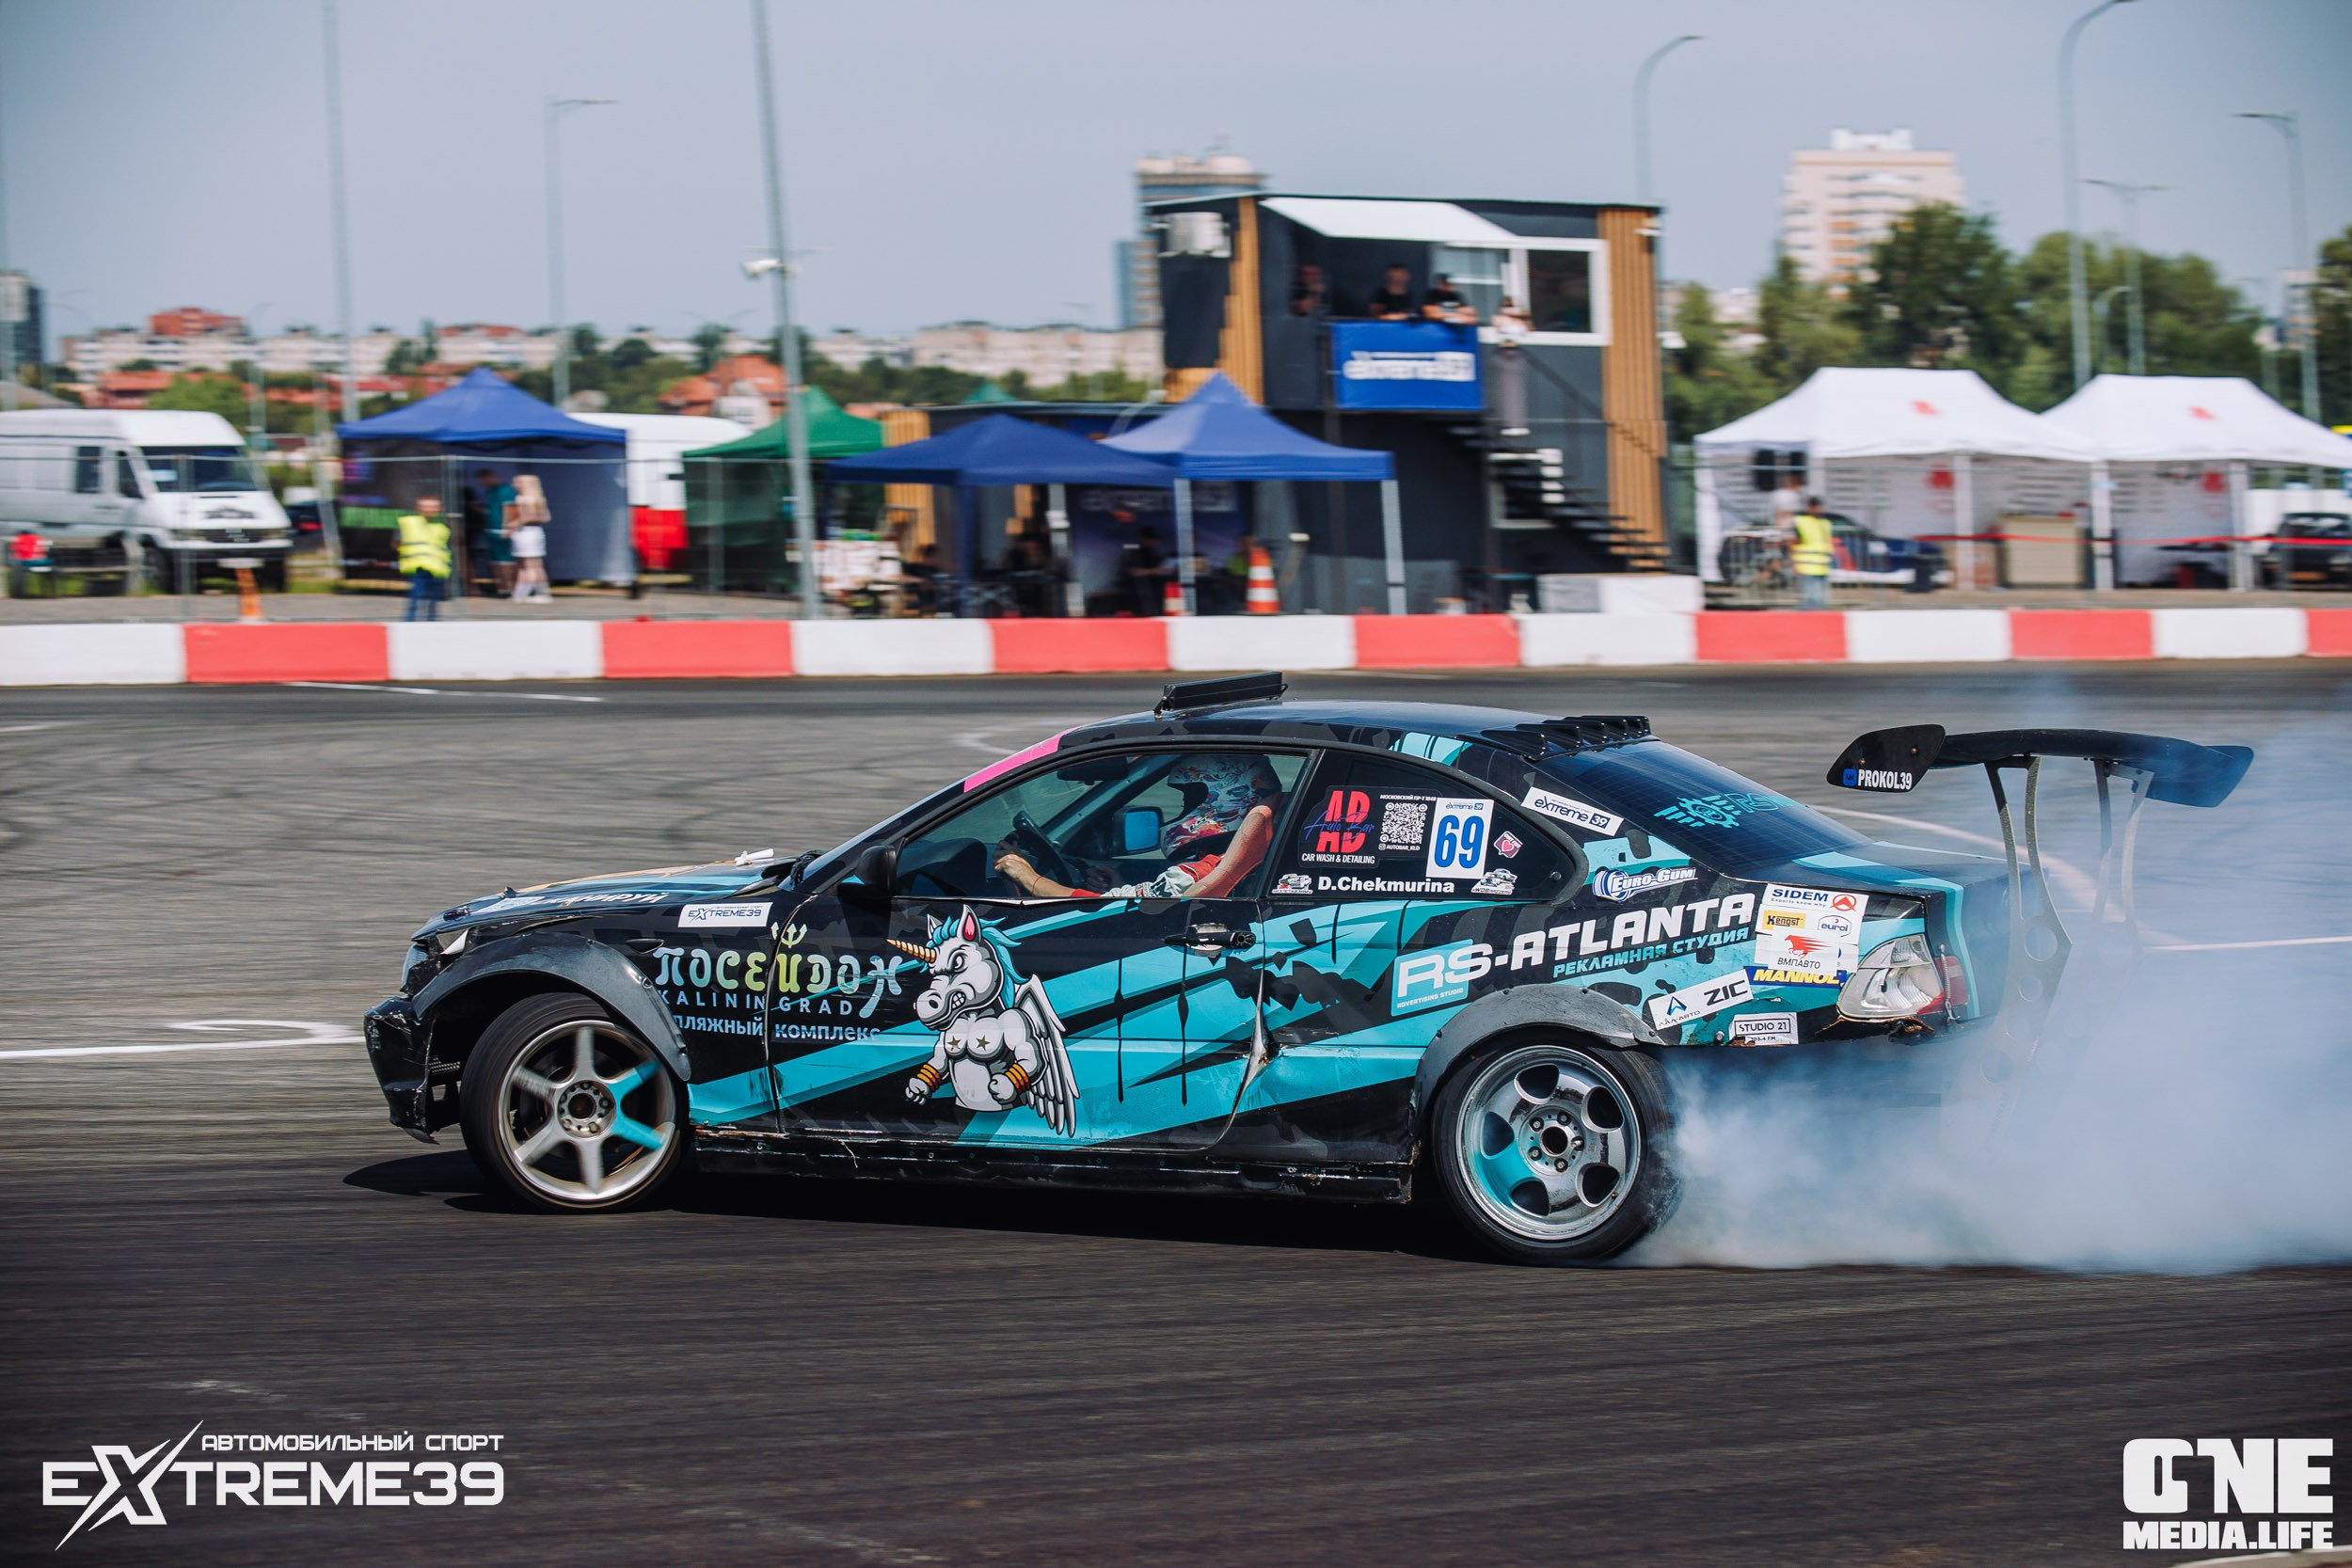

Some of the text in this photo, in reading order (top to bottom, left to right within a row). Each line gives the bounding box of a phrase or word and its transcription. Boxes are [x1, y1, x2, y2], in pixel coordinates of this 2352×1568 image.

[1857, 768, 1913, 790] PROKOL39
[1590, 814, 1610, 827] 39
[1434, 815, 1485, 869] 69
[1301, 852, 1375, 864] CAR WASH & DETAILING
[1318, 876, 1455, 894] D.Chekmurina
[1772, 888, 1829, 902] SIDEM
[1820, 923, 1849, 932] eurol
[1397, 893, 1756, 998] RS-ATLANTA
[1552, 927, 1750, 979] РЕКЛАМНАЯ СТУДИЯ
[1777, 958, 1821, 970] ВМПАВТО
[1753, 969, 1840, 985] MANNOL
[1396, 987, 1464, 1009] ADVERTISING STUDIO
[1704, 979, 1748, 1006] ZIC
[659, 990, 853, 1017] KALININGRAD
[673, 1014, 882, 1042] ПЛЯЖНЫЙ КОМПЛЕКС
[1739, 1022, 1787, 1032] STUDIO 21
